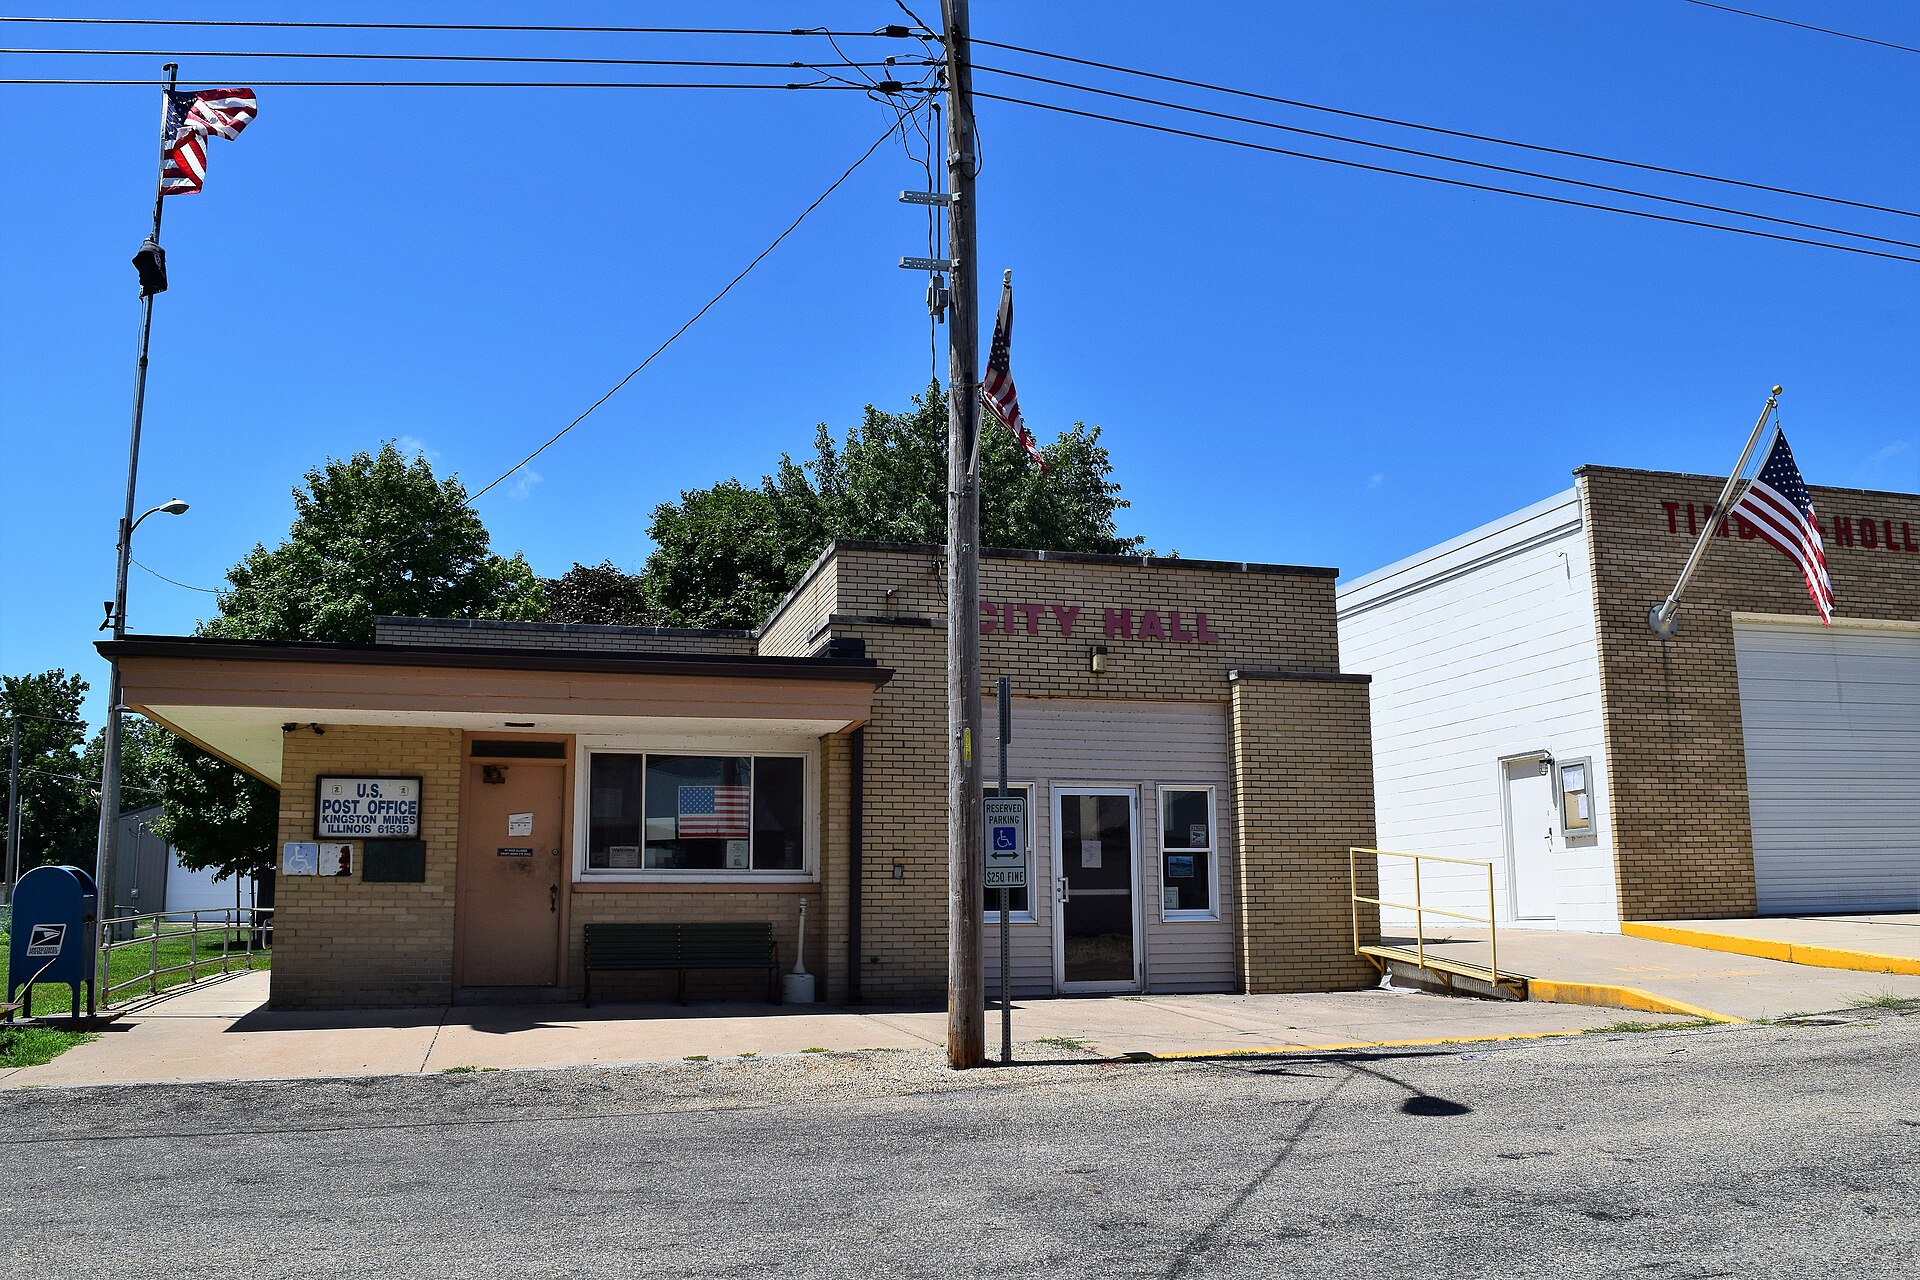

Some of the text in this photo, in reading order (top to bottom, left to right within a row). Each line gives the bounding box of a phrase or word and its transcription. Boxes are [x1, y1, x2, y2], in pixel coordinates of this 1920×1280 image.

[978, 601, 1220, 643] CITY HALL
[356, 783, 383, 799] U.S.
[322, 799, 417, 815] POST OFFICE
[986, 804, 1022, 813] RESERVED
[322, 814, 416, 825] KINGSTON MINES
[989, 815, 1020, 825] PARKING
[327, 824, 409, 834] ILLINOIS 61539
[986, 871, 1024, 883] $250 FINE
